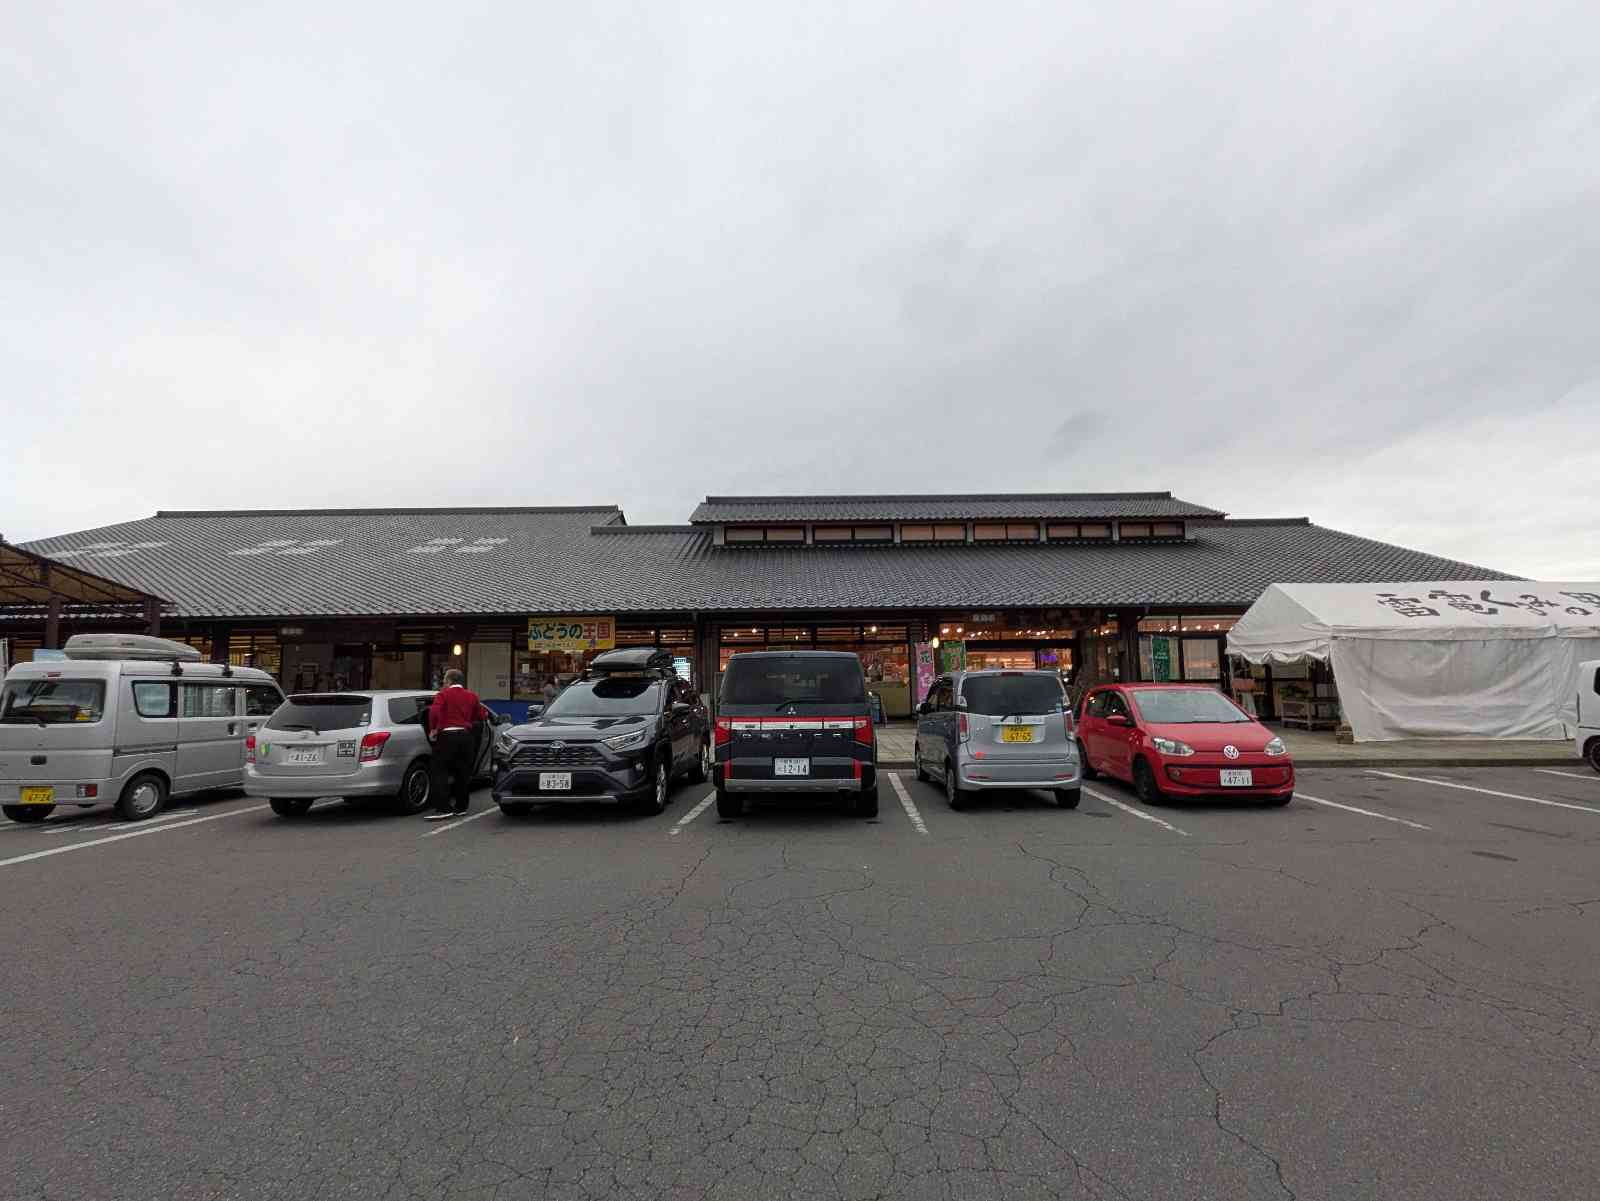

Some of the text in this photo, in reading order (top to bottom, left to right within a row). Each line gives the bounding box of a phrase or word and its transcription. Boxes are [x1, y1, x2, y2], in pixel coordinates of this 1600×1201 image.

[528, 623, 610, 640] ぶどうの王国
